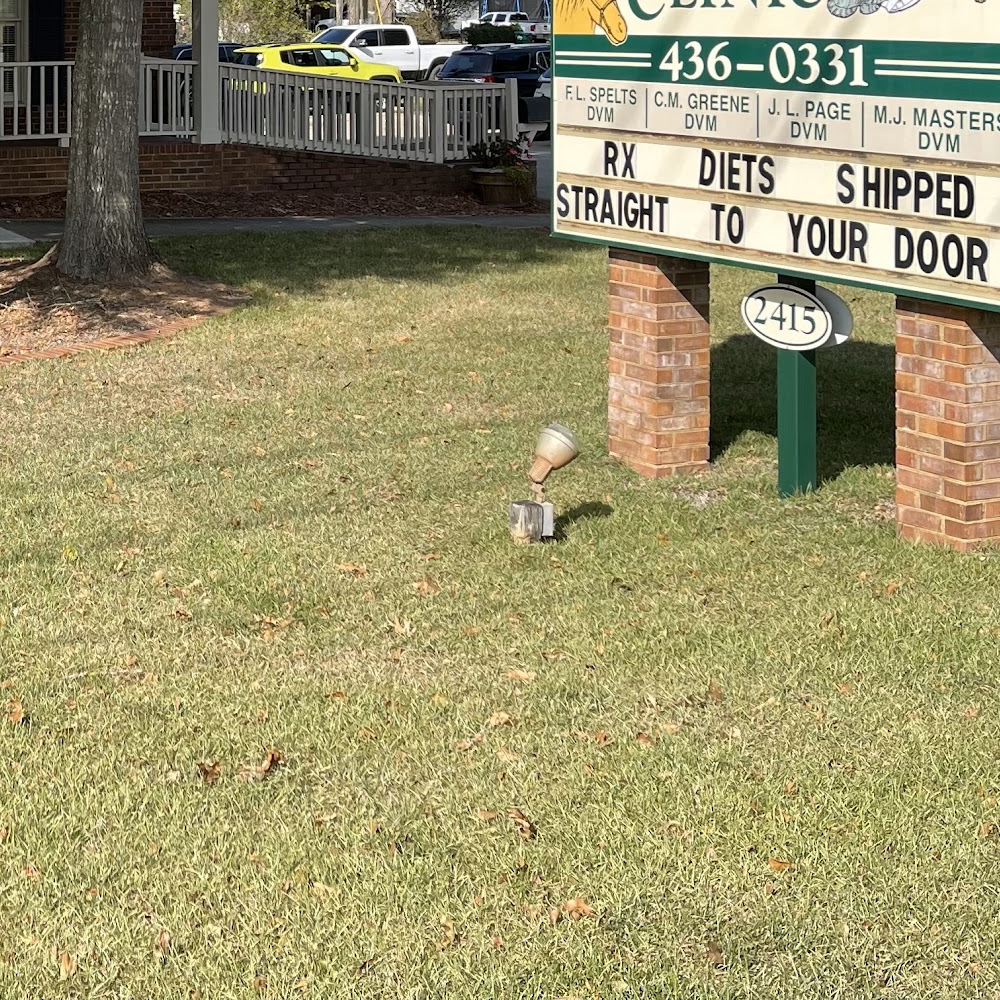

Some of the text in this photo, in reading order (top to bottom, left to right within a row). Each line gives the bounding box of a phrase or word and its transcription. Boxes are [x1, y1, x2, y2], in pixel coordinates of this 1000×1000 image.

[659, 40, 869, 87] 436-0331
[589, 86, 637, 105] SPELTS
[654, 91, 750, 113] C.M. GREENE
[587, 106, 614, 123] DVM
[805, 100, 851, 121] PAGE
[874, 105, 906, 125] M.J.
[685, 113, 717, 132] DVM
[791, 121, 827, 142] DVM
[919, 131, 960, 153] DVM
[603, 140, 975, 219] RX DIETS SHIPPED
[557, 183, 988, 282] STRAIGHT TO YOUR DOOR
[754, 296, 817, 335] 2415
